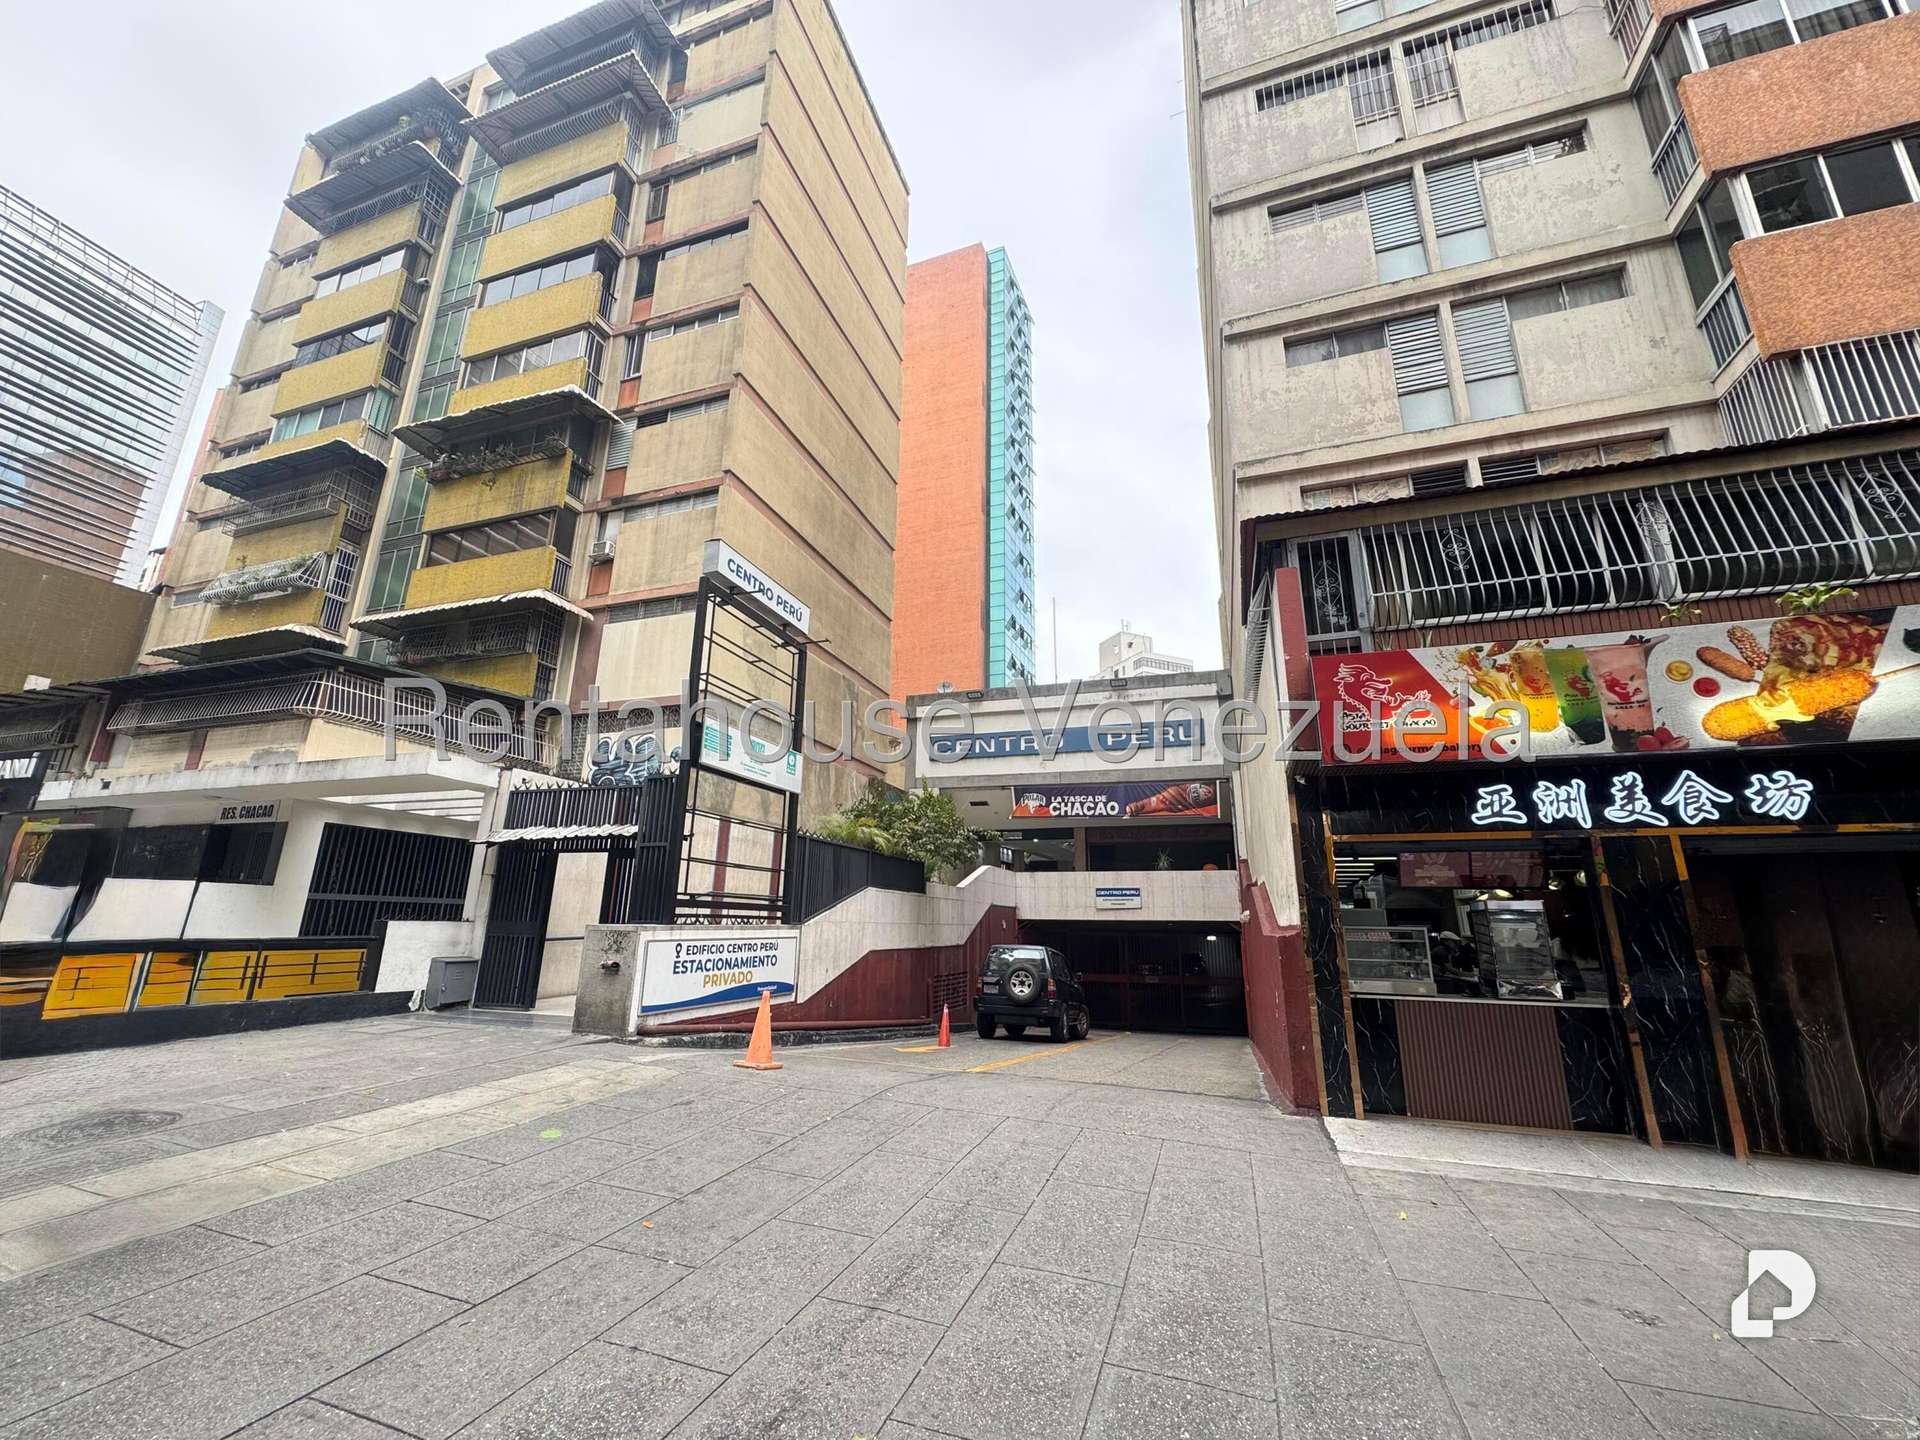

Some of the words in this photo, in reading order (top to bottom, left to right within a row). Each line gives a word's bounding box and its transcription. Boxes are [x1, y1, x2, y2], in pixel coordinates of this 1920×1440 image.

[727, 558, 774, 601] CENTRO
[776, 594, 803, 622] PERÚ
[1341, 719, 1390, 731] GOURET
[1471, 770, 1814, 829] 亚洲美食坊
[221, 807, 237, 820] RES.
[239, 804, 274, 819] CHACAO
[1049, 801, 1119, 816] CHACAO
[686, 943, 725, 956] EDIFICIO
[726, 942, 758, 955] CENTRO
[759, 940, 779, 952] PERÚ
[672, 954, 778, 975] ESTACIONAMIENTO
[703, 971, 753, 988] PRIVADO
